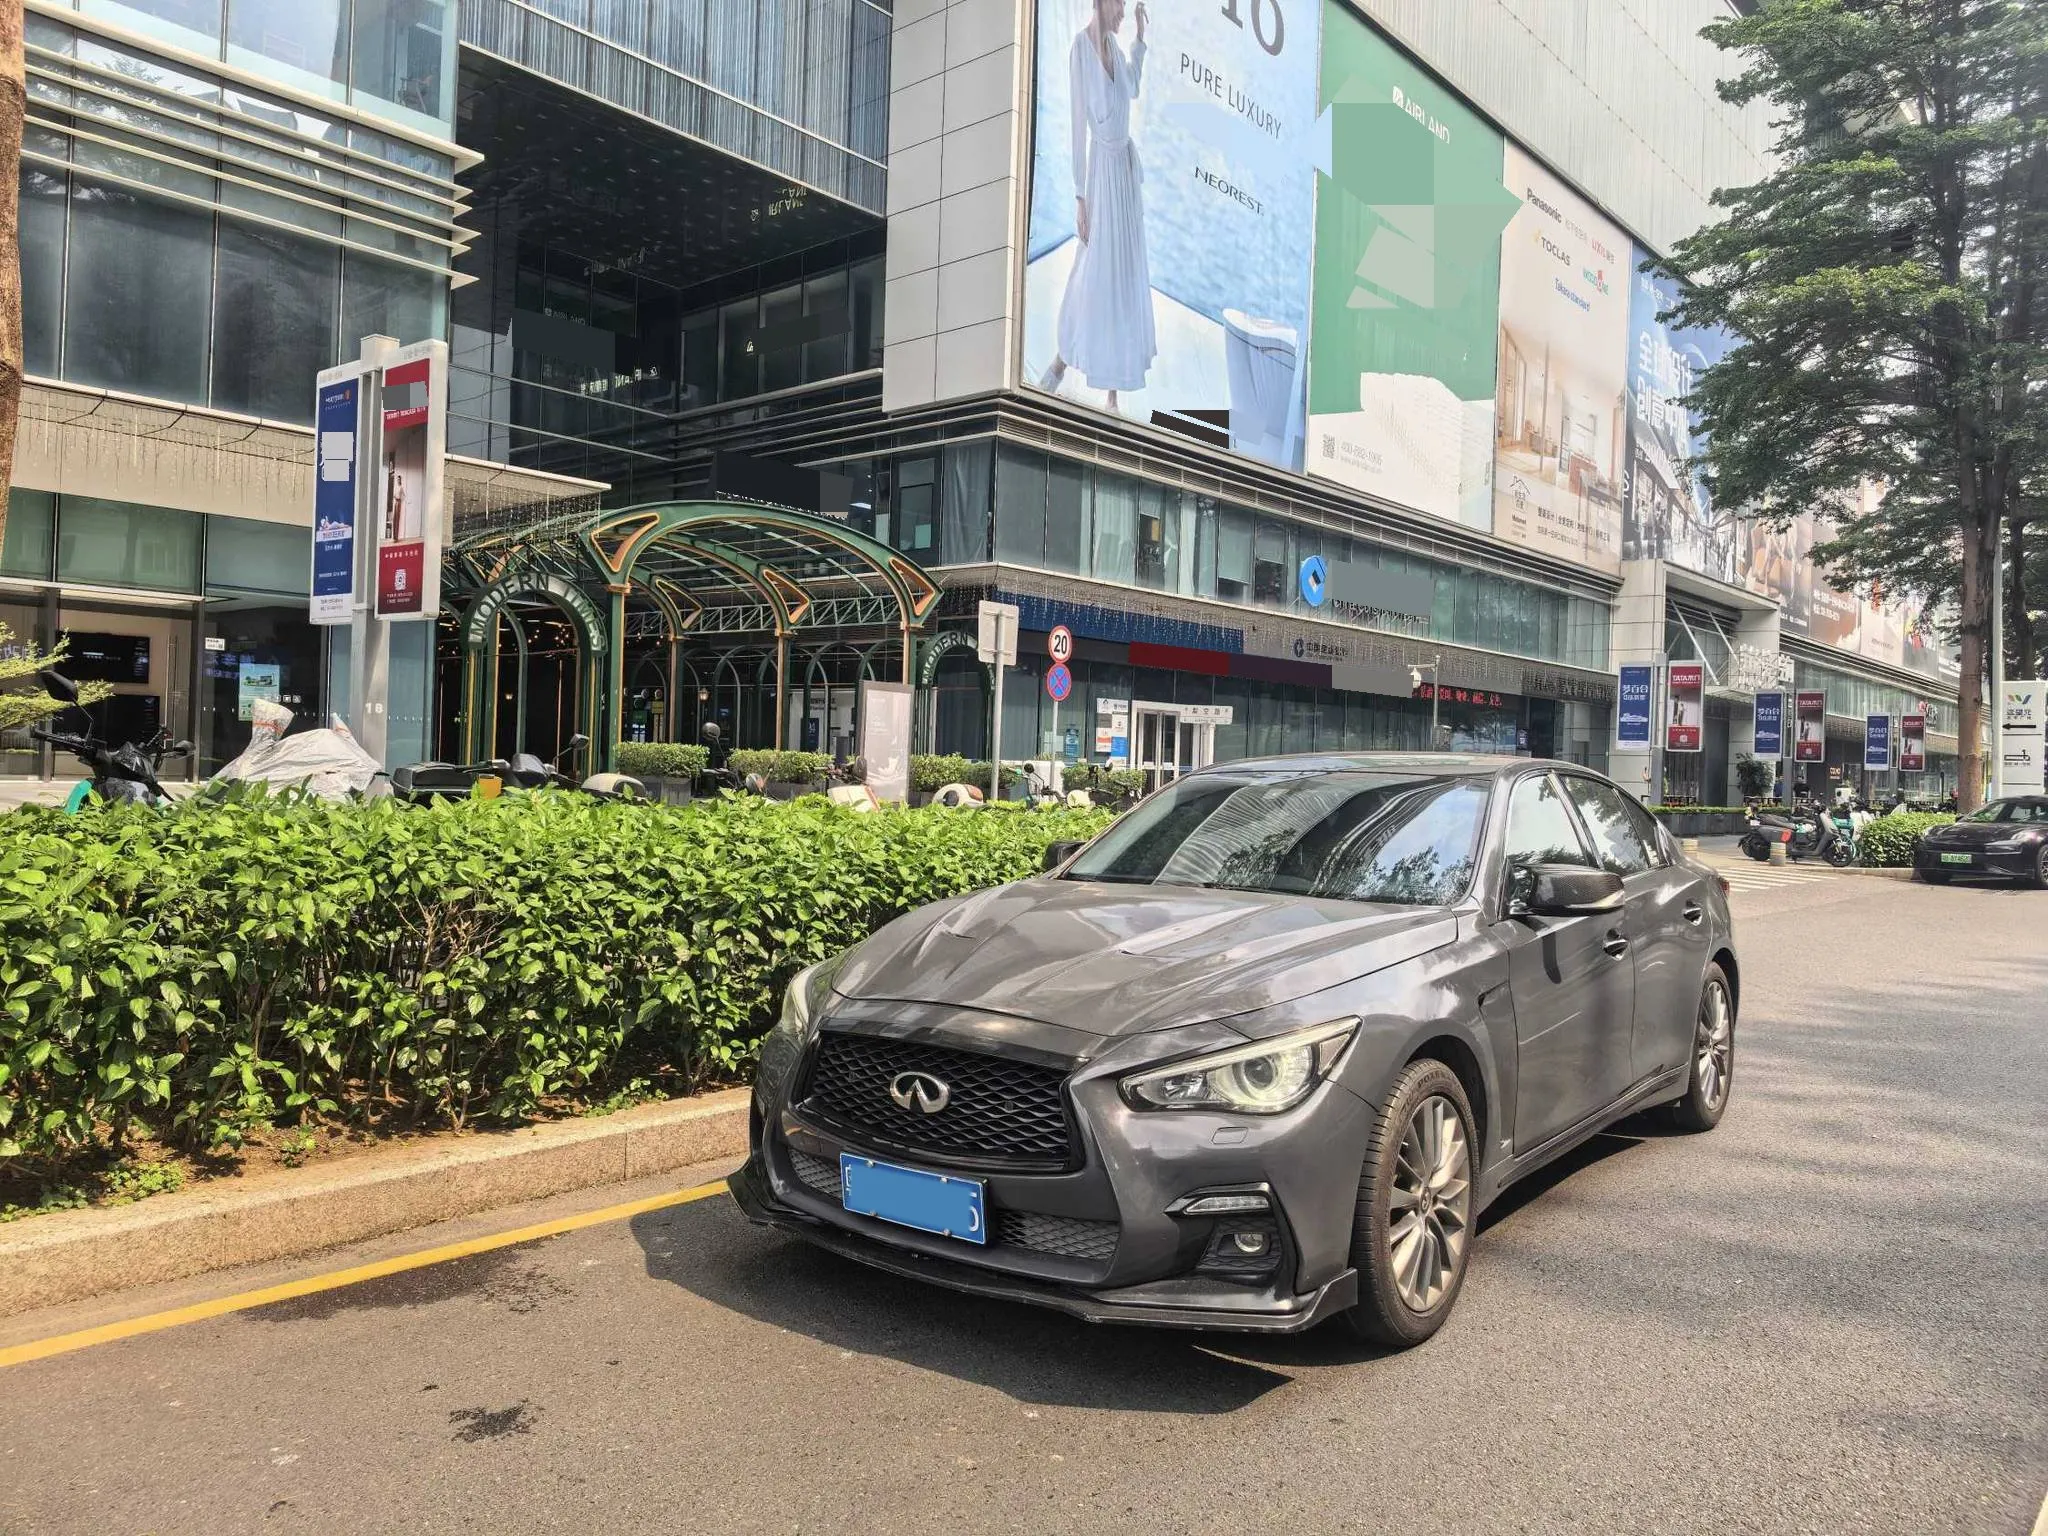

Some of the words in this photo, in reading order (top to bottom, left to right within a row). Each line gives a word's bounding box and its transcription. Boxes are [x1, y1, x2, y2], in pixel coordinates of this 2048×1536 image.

[1180, 52, 1222, 98] PURE
[1228, 84, 1282, 140] LUXURY
[1195, 166, 1263, 215] NEOREST
[1527, 187, 1562, 223] Panasonic
[1541, 236, 1571, 266] TOCLAS
[469, 572, 549, 638] MODERN
[1053, 634, 1068, 655] 20
[1622, 684, 1649, 696] 梦百合
